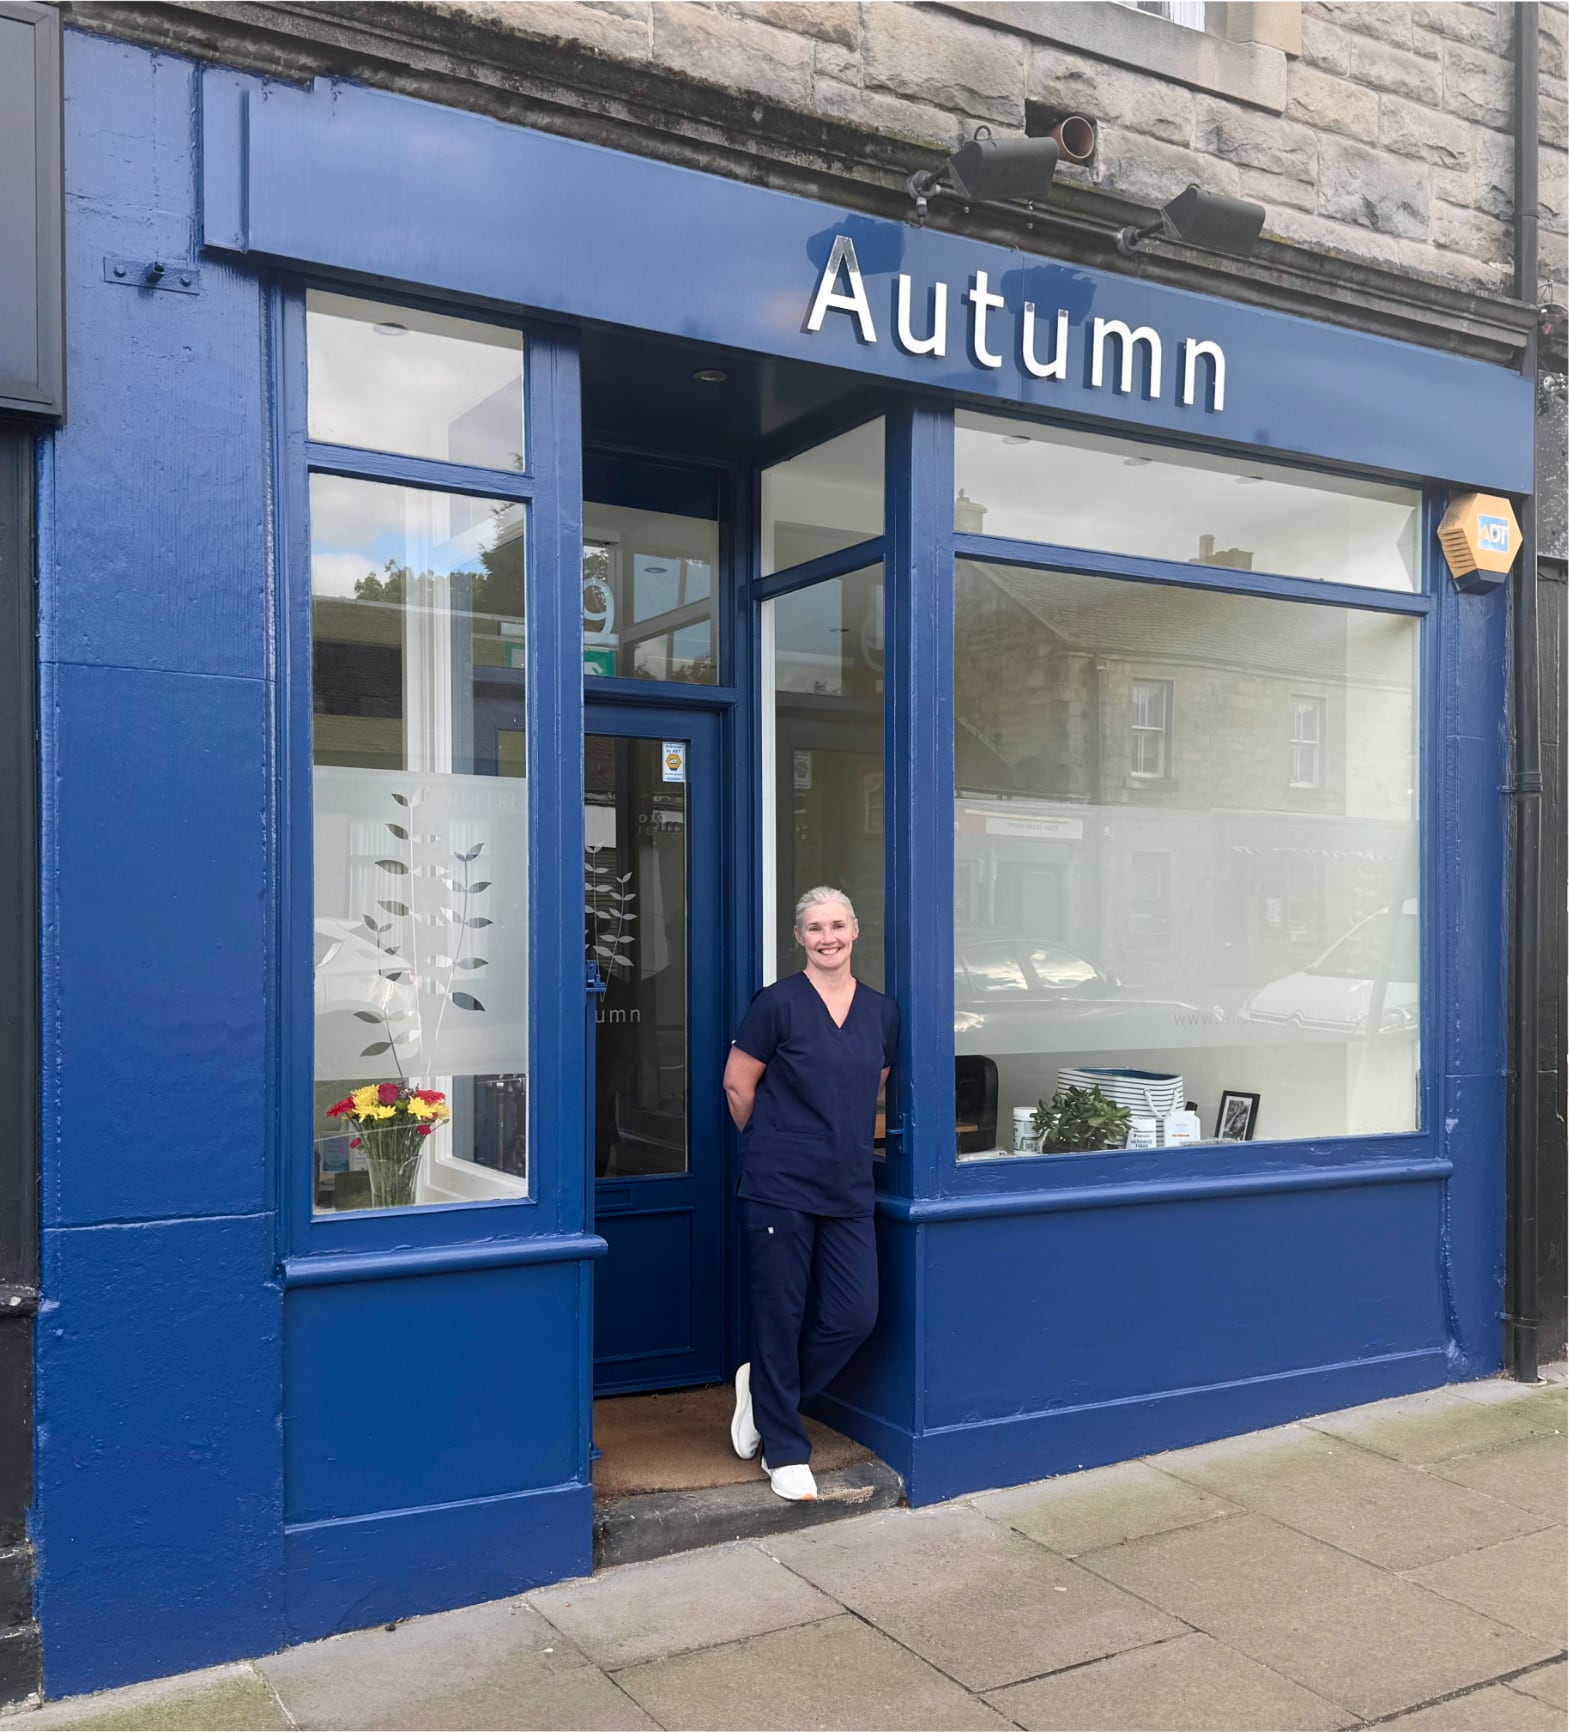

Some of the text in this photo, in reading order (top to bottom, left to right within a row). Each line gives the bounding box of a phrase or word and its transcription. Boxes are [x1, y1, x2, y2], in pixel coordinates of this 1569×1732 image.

[806, 234, 1226, 412] Autumn
[1479, 523, 1508, 545] ADT
[595, 1009, 641, 1024] umn
